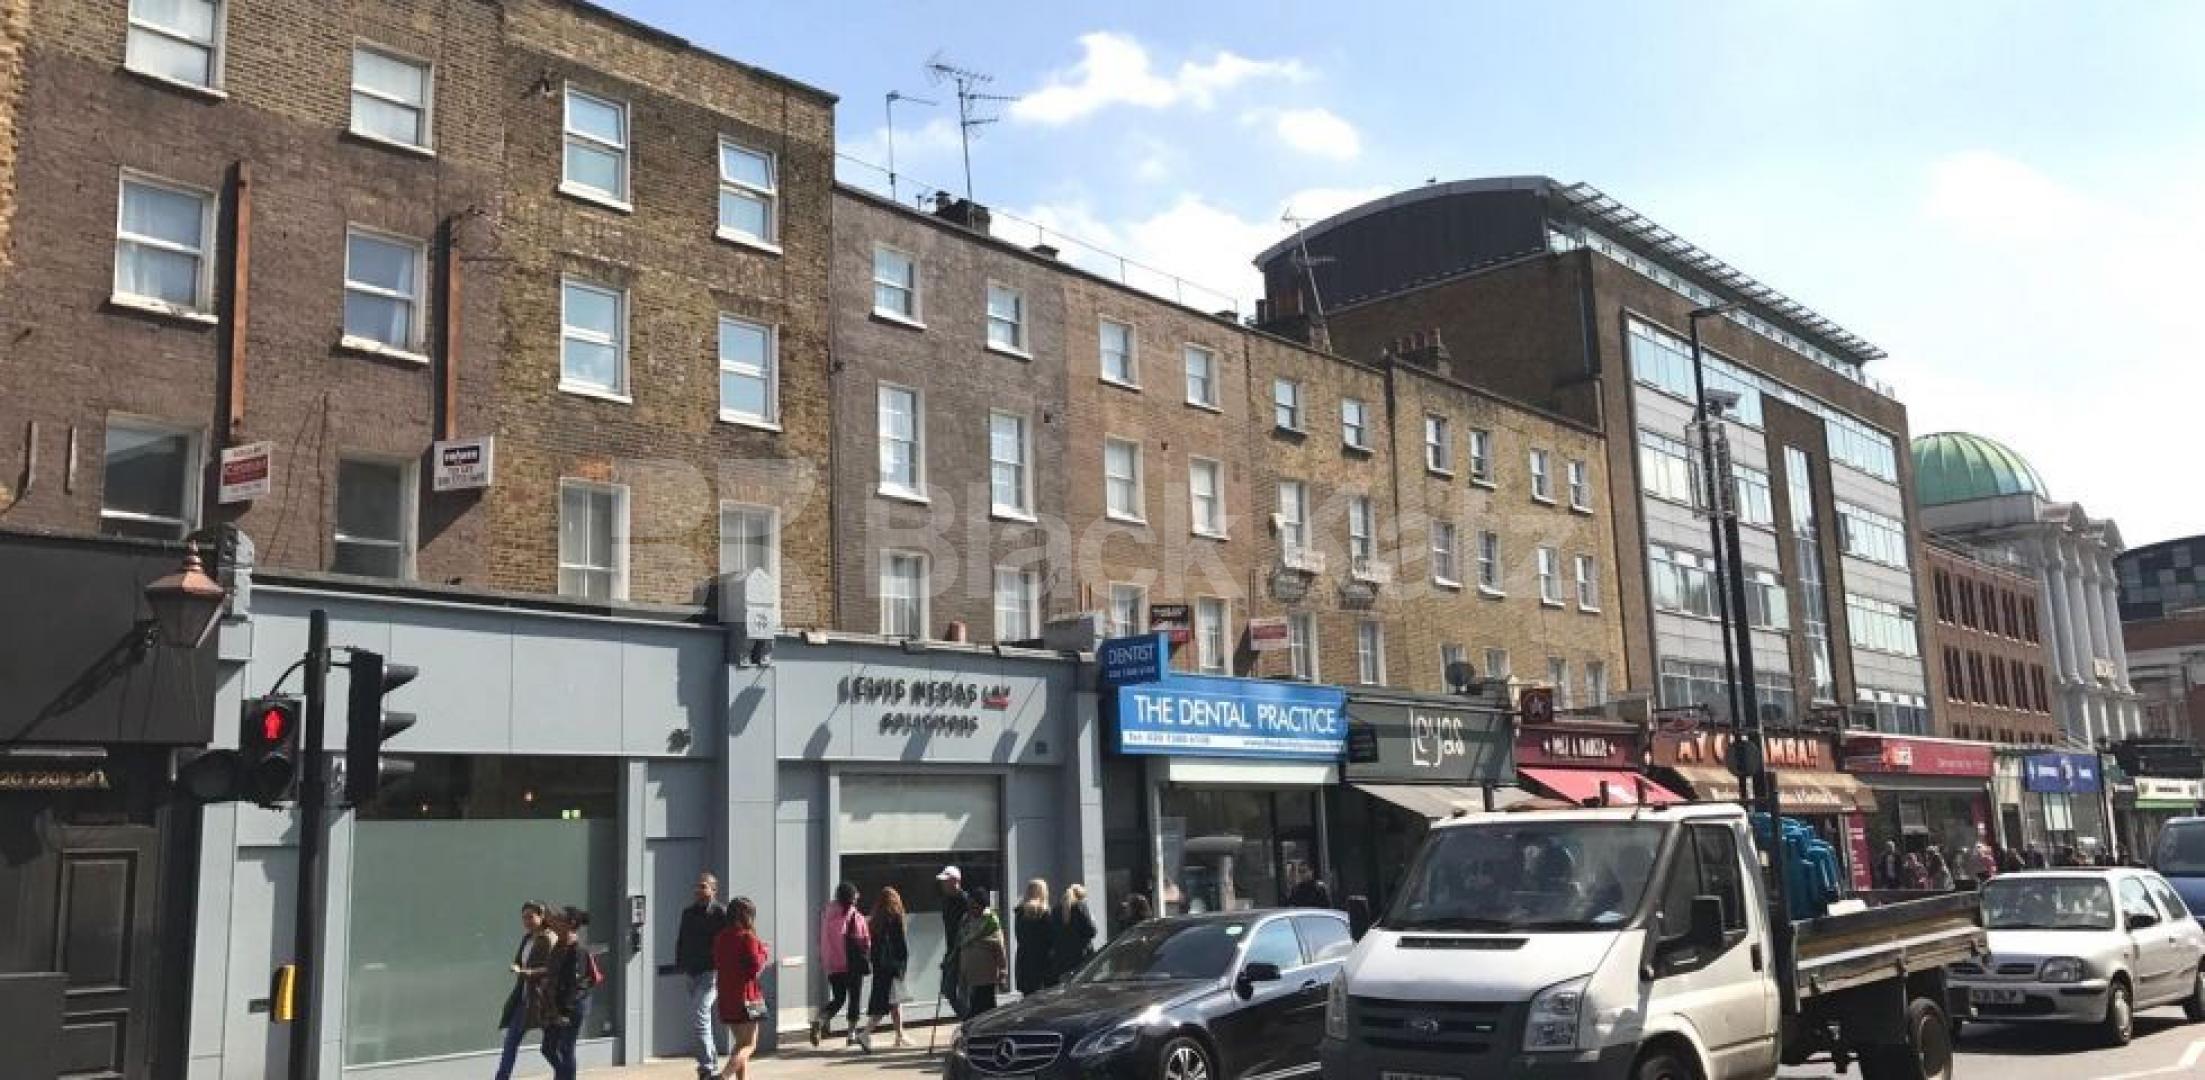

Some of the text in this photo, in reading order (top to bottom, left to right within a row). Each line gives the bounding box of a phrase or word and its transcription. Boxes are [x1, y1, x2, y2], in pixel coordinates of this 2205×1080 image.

[1108, 644, 1153, 665] DENTIST
[836, 676, 906, 704] LEWIS
[909, 680, 978, 708] NEDAS
[879, 713, 979, 738] SOLICITORS
[1133, 695, 1337, 734] THE DENTAL PRACTICE
